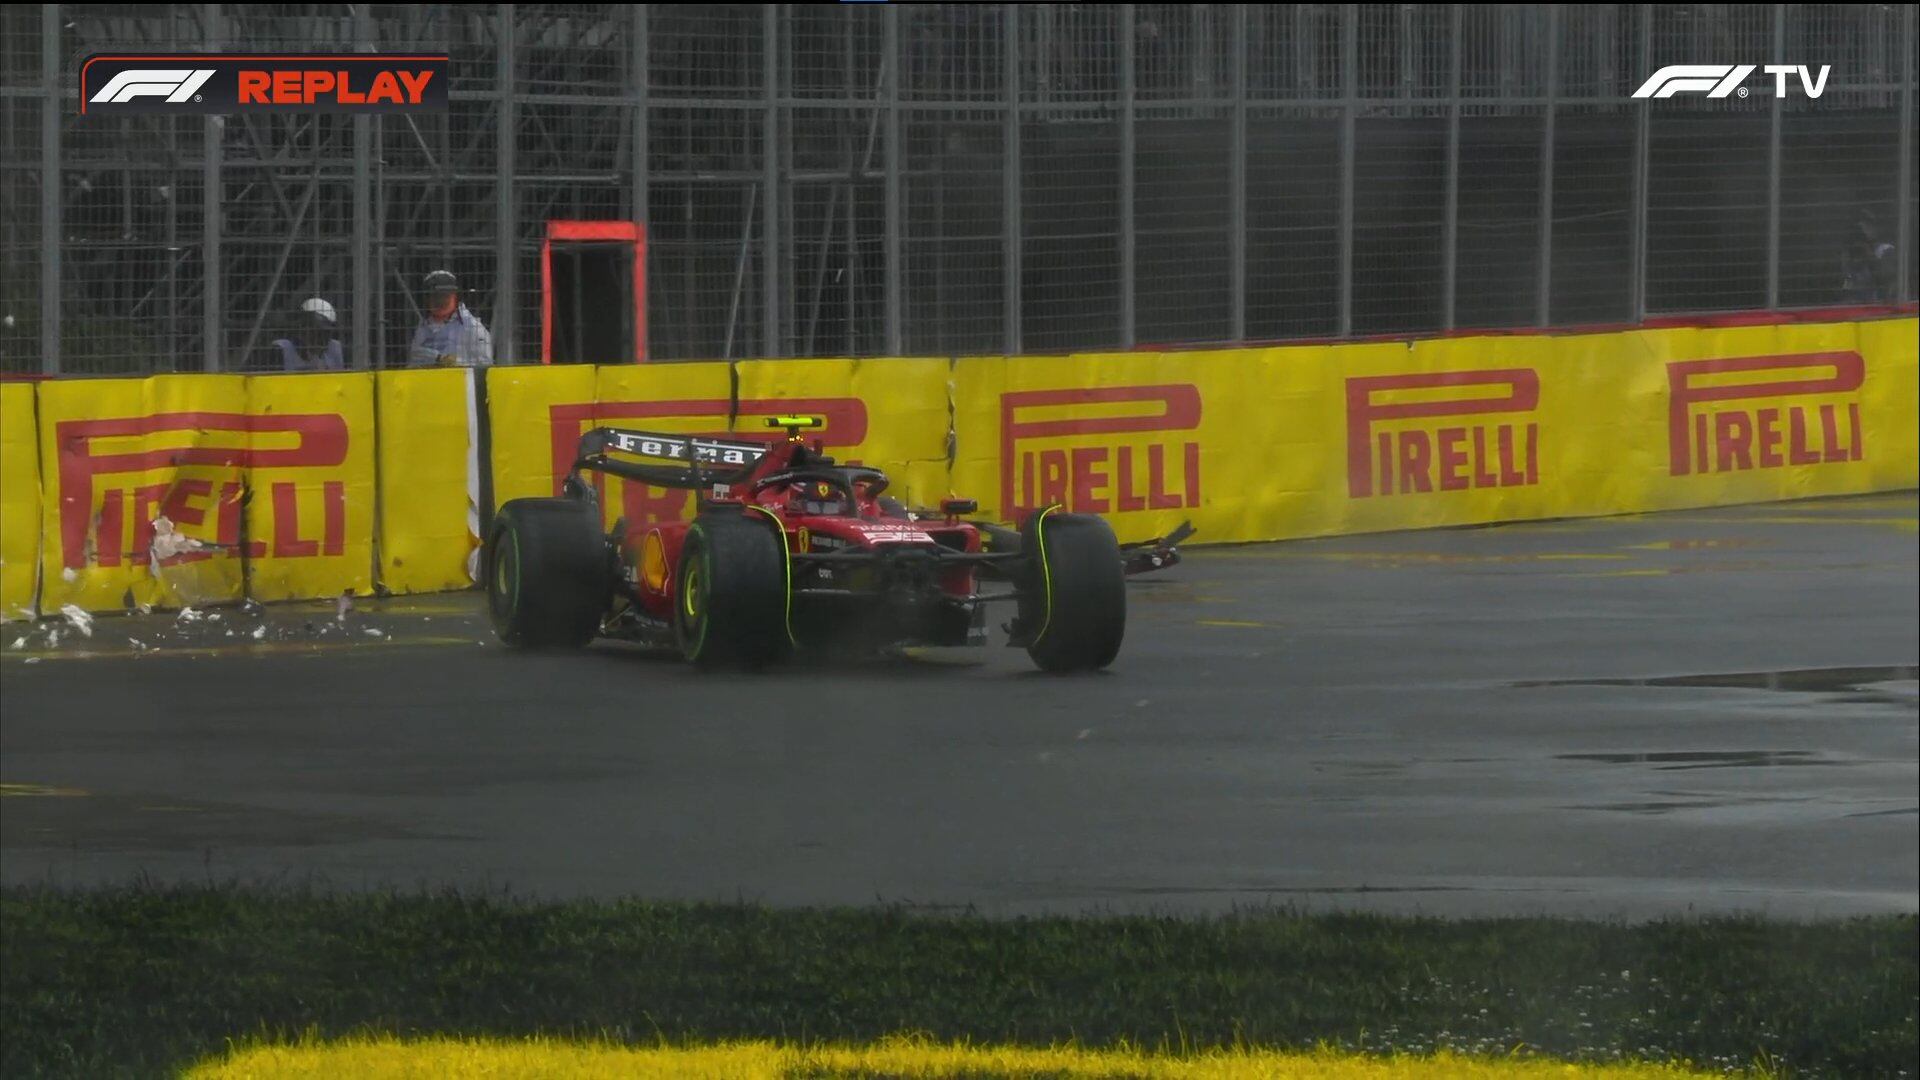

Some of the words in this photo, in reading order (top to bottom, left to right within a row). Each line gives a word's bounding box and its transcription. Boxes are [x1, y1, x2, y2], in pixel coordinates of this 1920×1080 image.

[1000, 384, 1202, 523] PIRELLI
[1345, 368, 1540, 498] PIRELLI
[1666, 350, 1865, 477] PIRELLI
